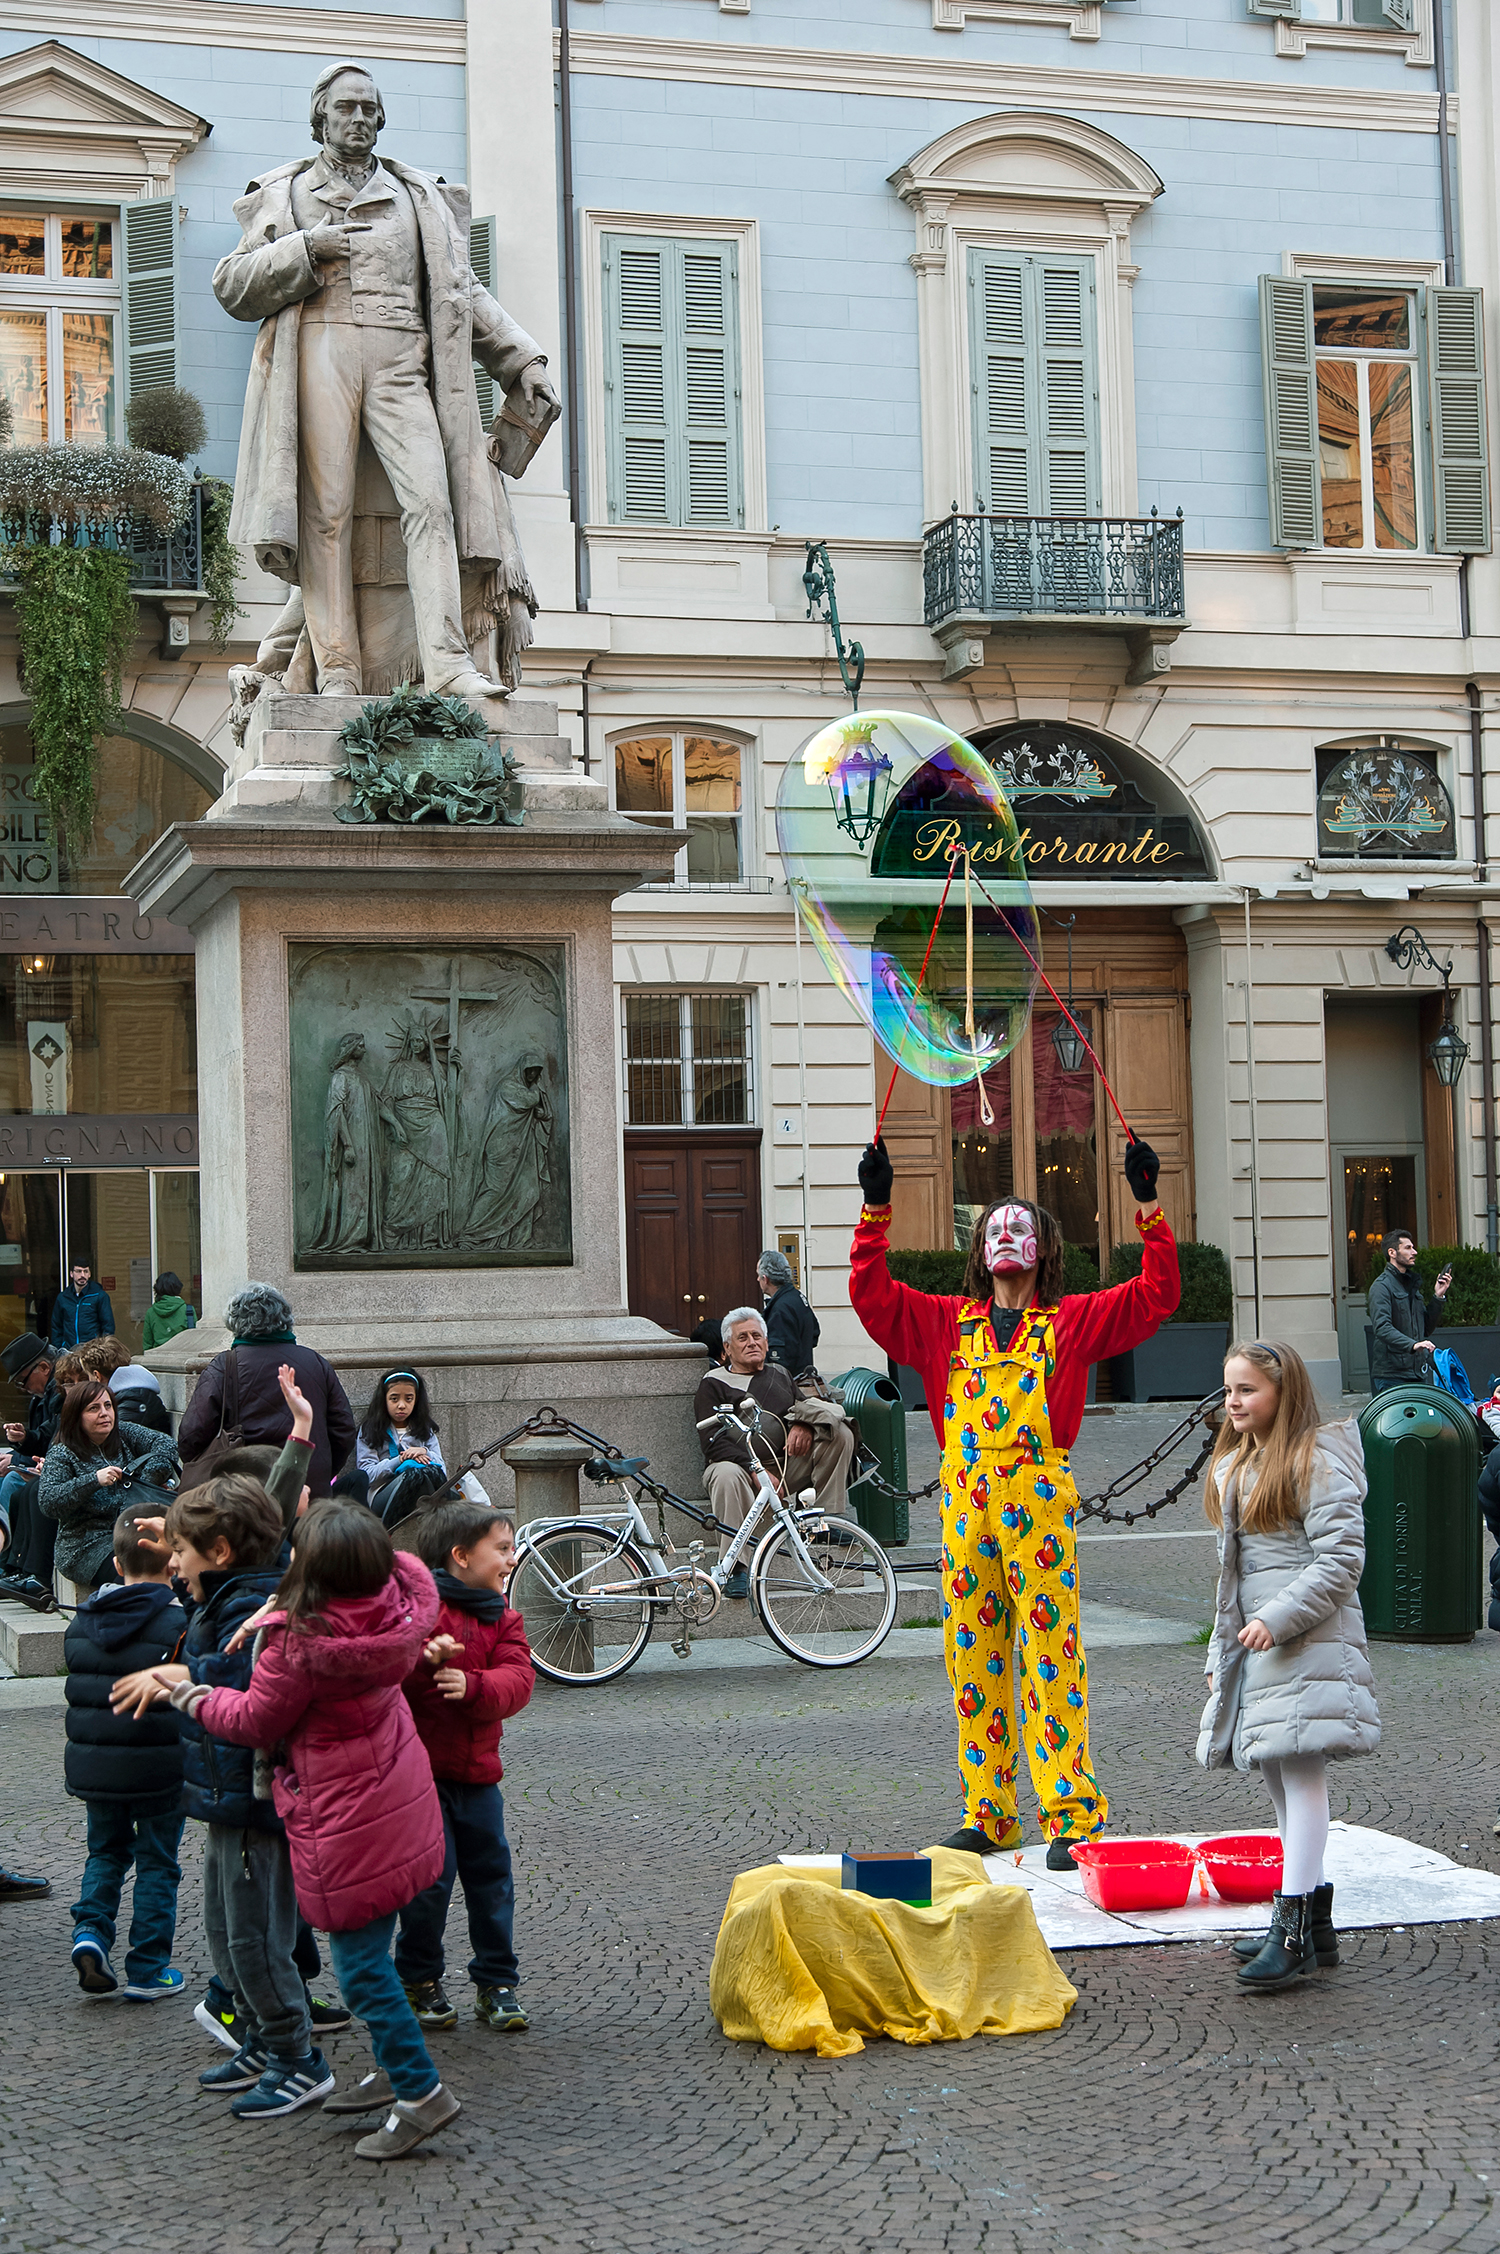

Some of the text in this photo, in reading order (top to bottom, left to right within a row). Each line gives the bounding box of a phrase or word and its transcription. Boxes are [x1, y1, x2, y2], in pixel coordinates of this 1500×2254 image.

[912, 818, 1185, 864] Ristorante
[0, 912, 155, 941] EATRO
[0, 1125, 196, 1156] RIGNANO
[782, 1120, 790, 1132] 4
[1395, 1502, 1407, 1558] TORINO
[1395, 1564, 1407, 1578] DI
